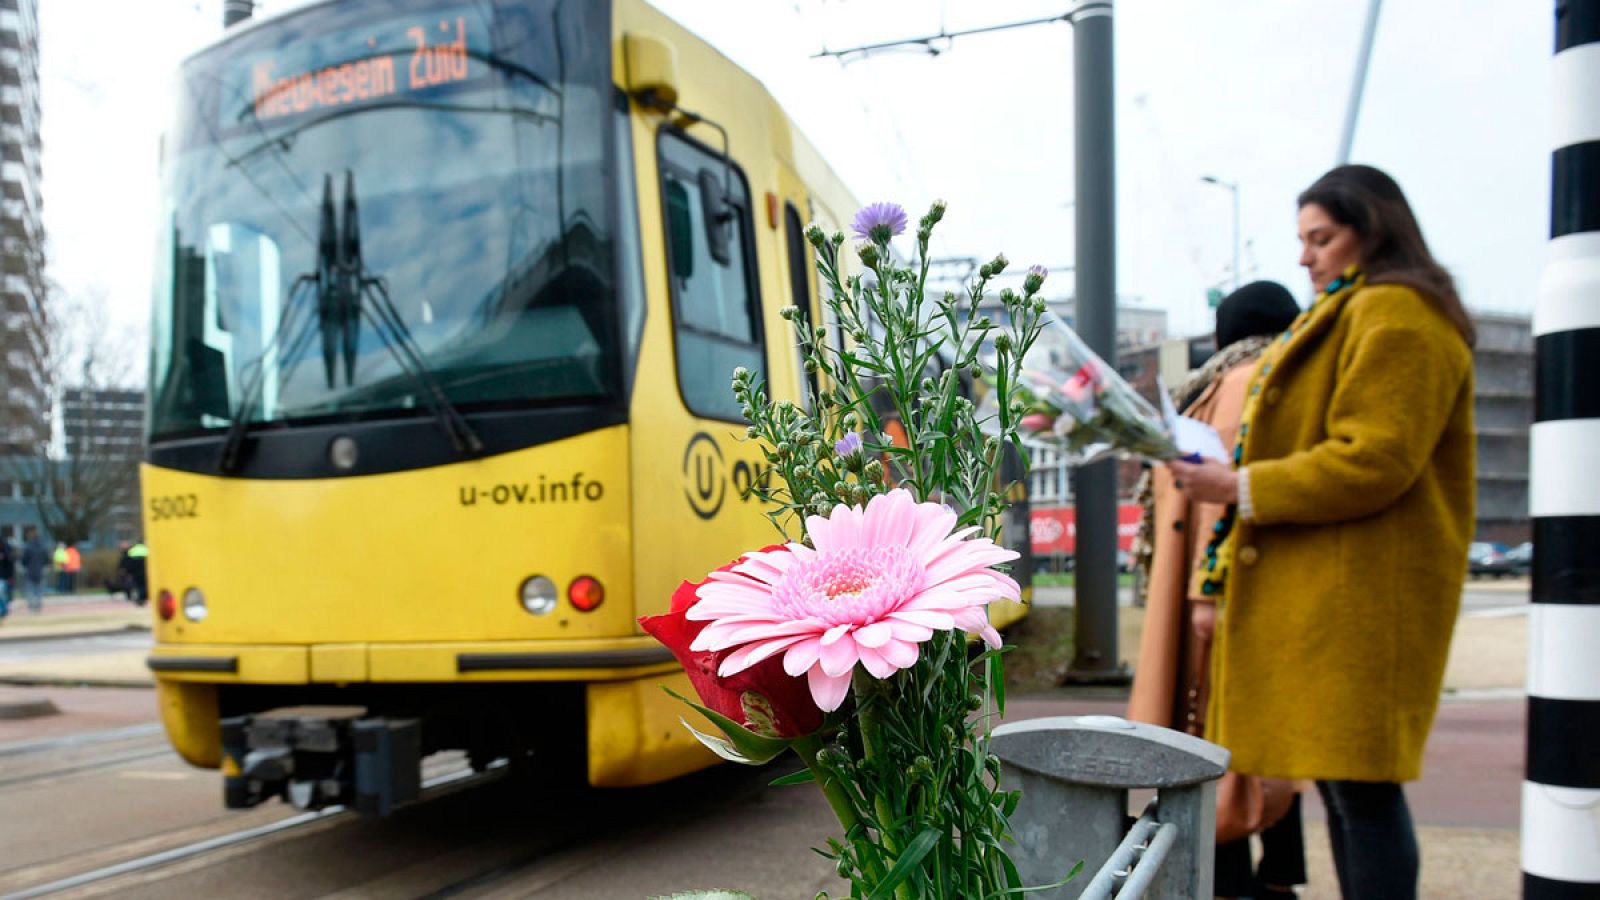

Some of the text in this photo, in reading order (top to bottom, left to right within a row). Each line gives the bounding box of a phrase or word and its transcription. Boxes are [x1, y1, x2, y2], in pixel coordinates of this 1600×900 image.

[407, 16, 468, 89] Zuid
[459, 471, 604, 506] u-ov.info
[151, 493, 200, 522] 5002
